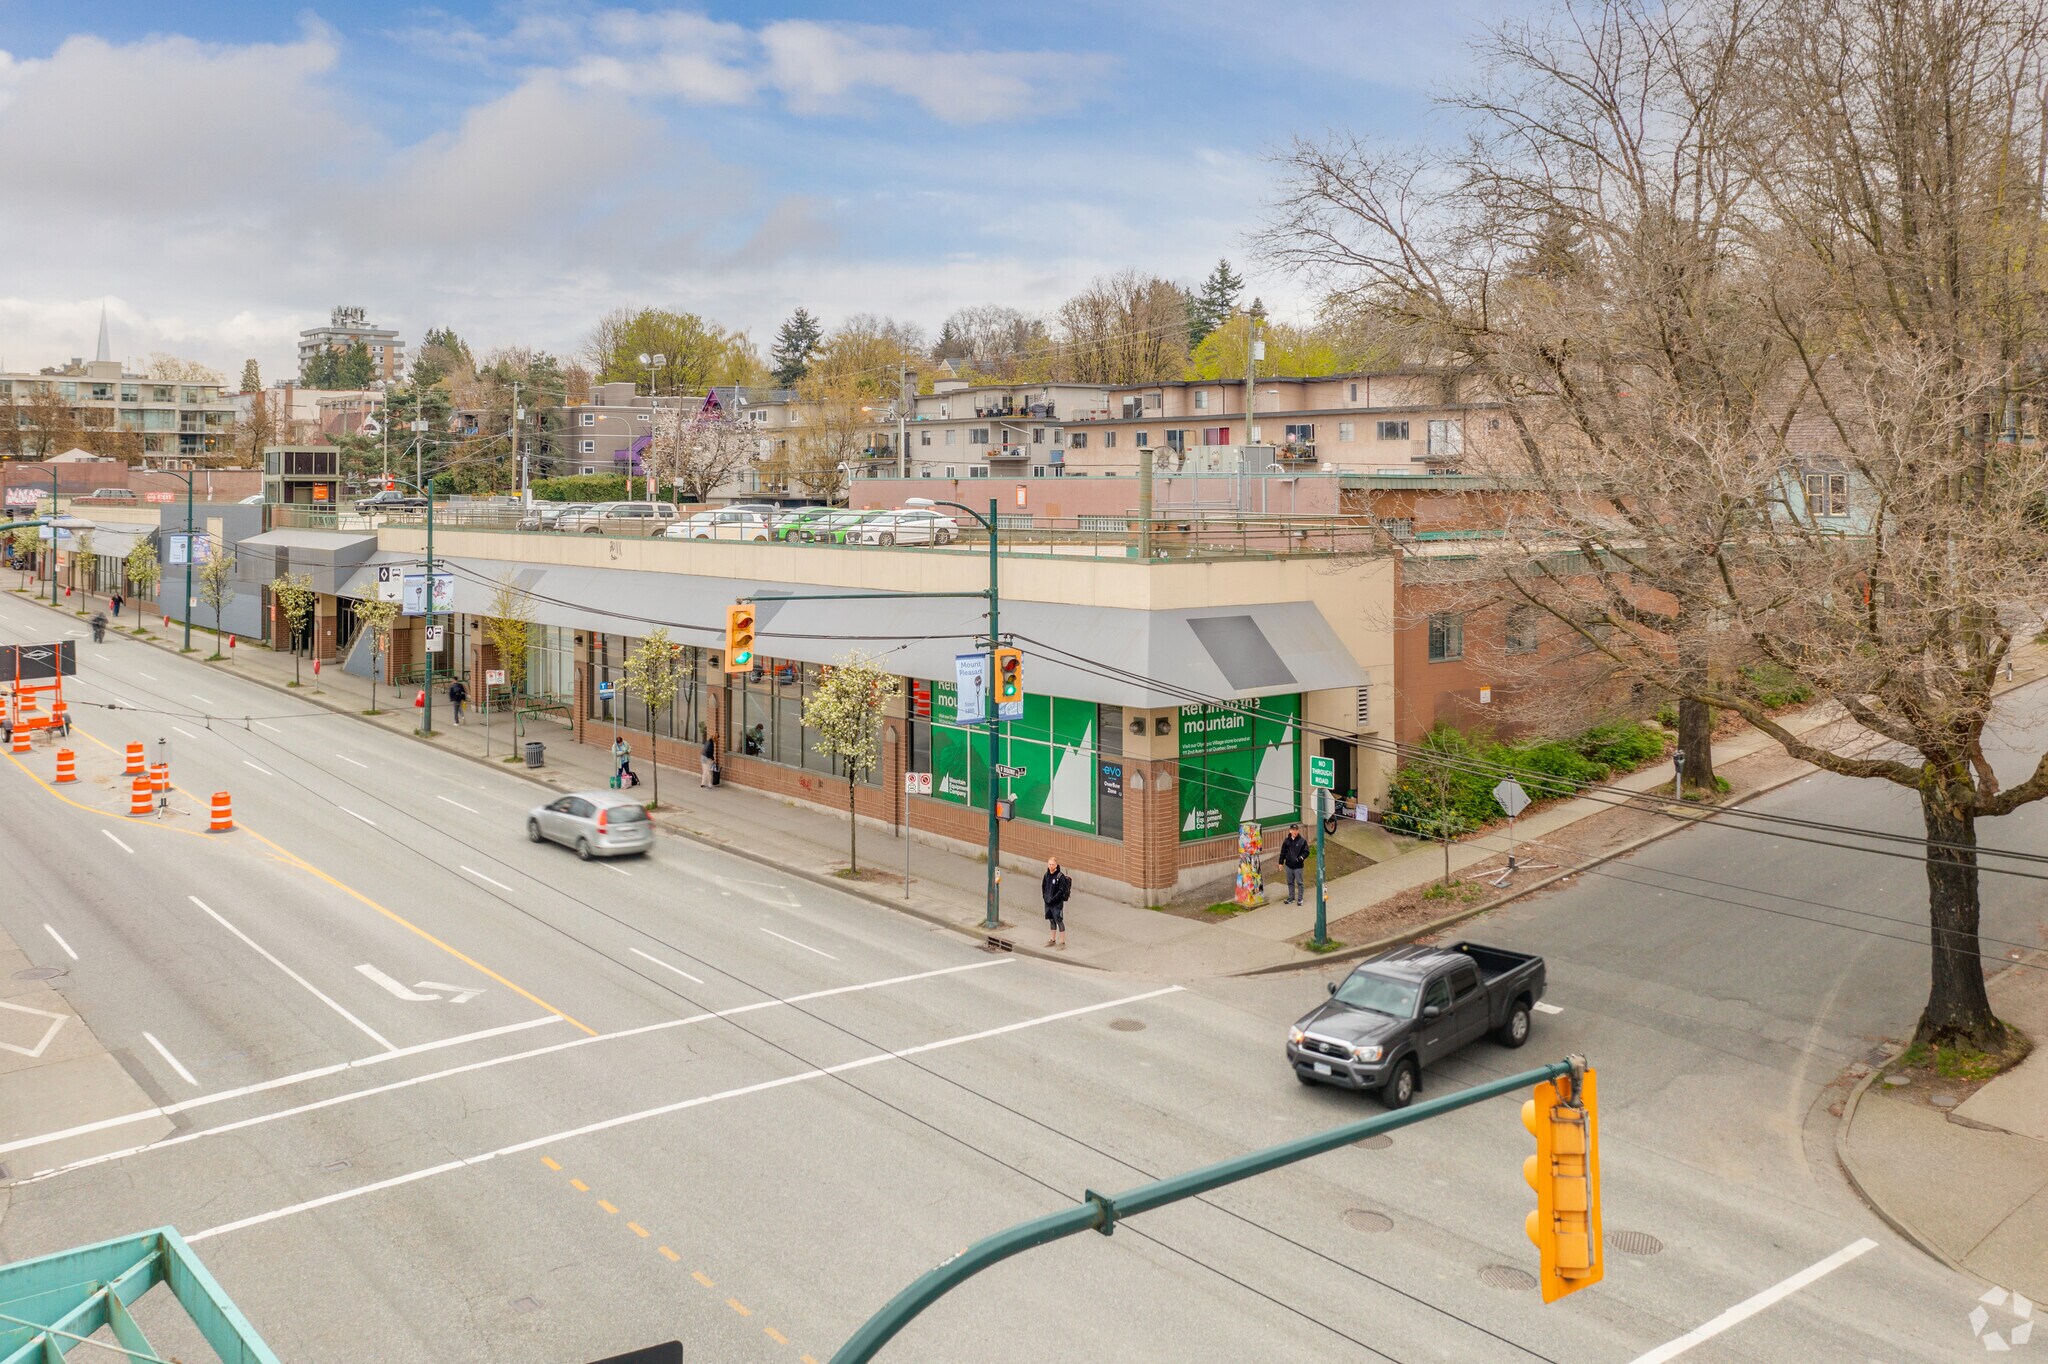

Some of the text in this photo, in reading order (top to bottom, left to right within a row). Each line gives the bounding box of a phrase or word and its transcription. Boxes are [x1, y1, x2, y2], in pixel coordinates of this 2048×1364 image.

[1184, 712, 1244, 734] mountain
[1102, 765, 1121, 777] evo
[1311, 768, 1333, 777] THROUGH
[1315, 776, 1329, 785] ROAD
[1196, 808, 1219, 818] Montain
[1196, 814, 1223, 824] Eqpment
